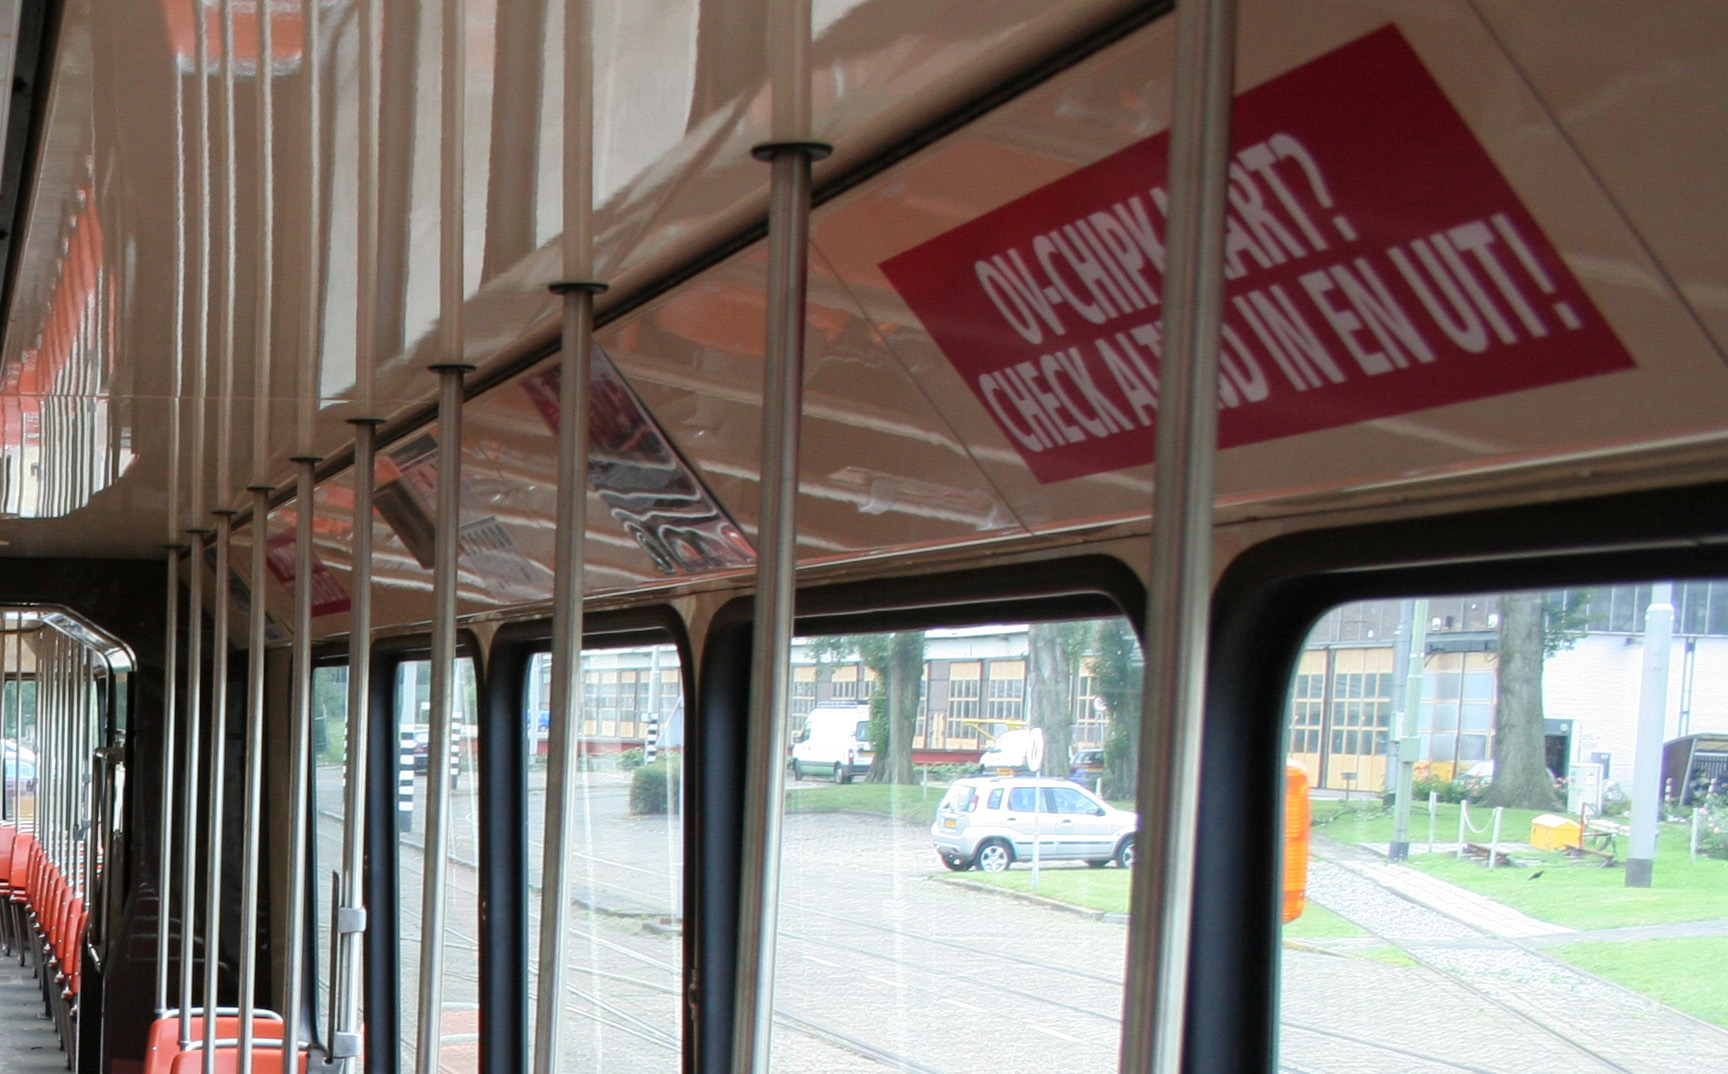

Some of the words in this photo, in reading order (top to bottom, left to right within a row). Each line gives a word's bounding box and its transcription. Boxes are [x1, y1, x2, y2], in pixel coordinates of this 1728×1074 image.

[975, 133, 1359, 345] OV-CHIPKART?
[979, 347, 1134, 452] CHECK
[1233, 284, 1346, 392] IN
[1298, 257, 1437, 376] EN
[1386, 213, 1582, 354] UIT!
